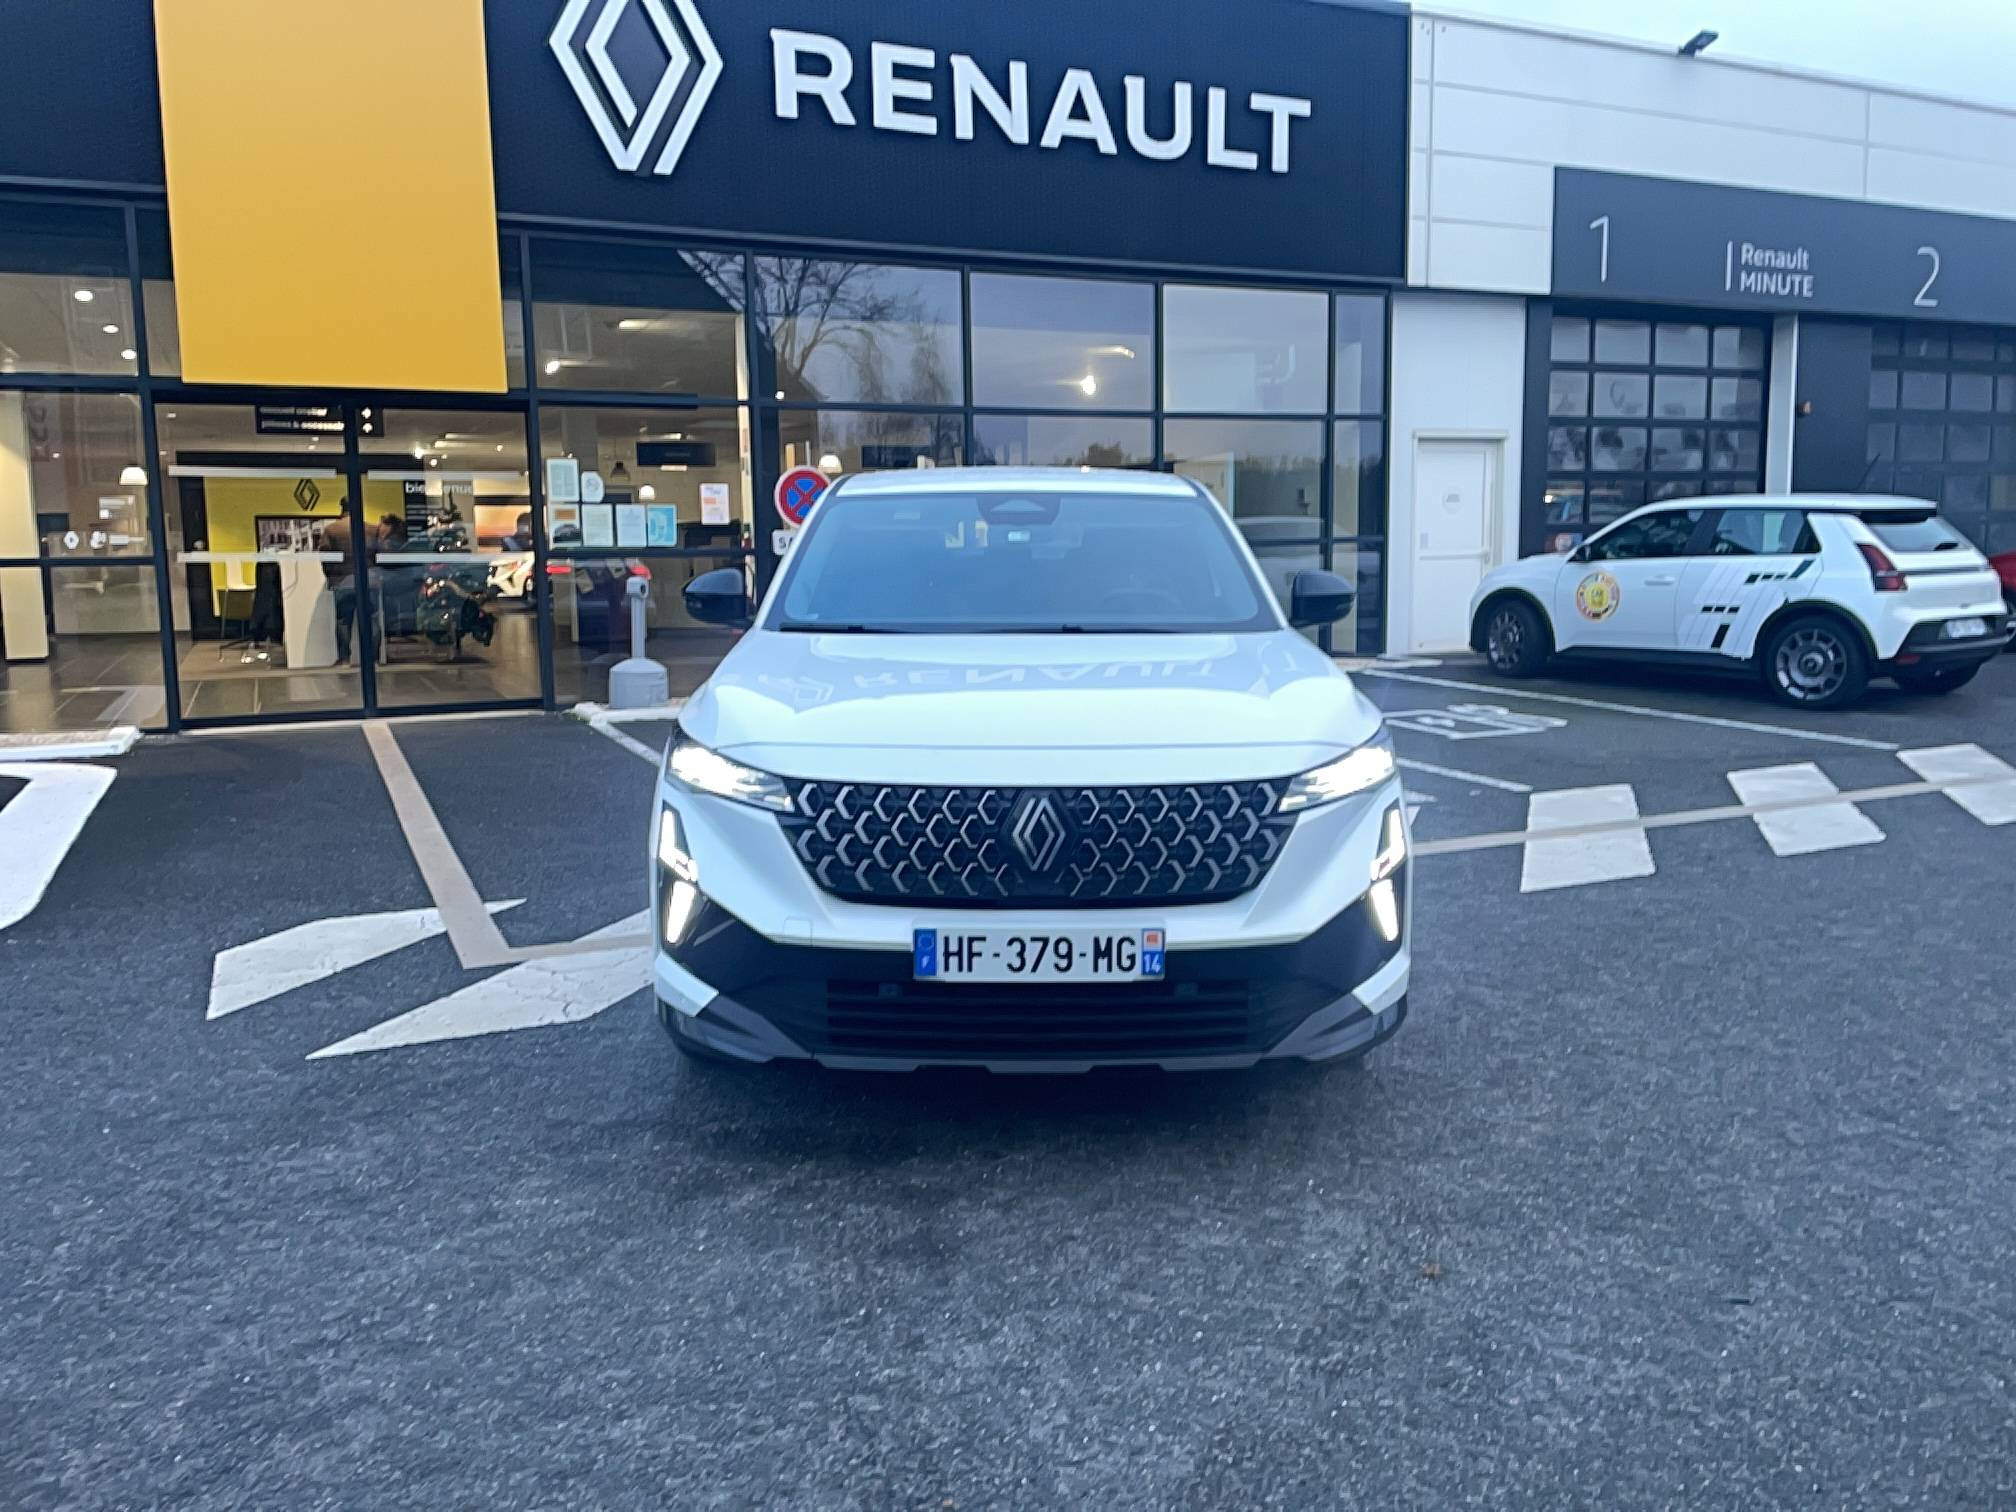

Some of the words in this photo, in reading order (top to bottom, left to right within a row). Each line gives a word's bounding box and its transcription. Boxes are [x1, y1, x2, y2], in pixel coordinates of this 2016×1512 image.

[769, 27, 1312, 174] RENAULT
[1589, 214, 1610, 283] 1
[1740, 242, 1810, 272] Renault
[1739, 270, 1814, 298] MINUTE
[1912, 246, 1941, 308] 2
[942, 935, 1137, 973] HF-379-MG
[1143, 953, 1162, 974] 14
